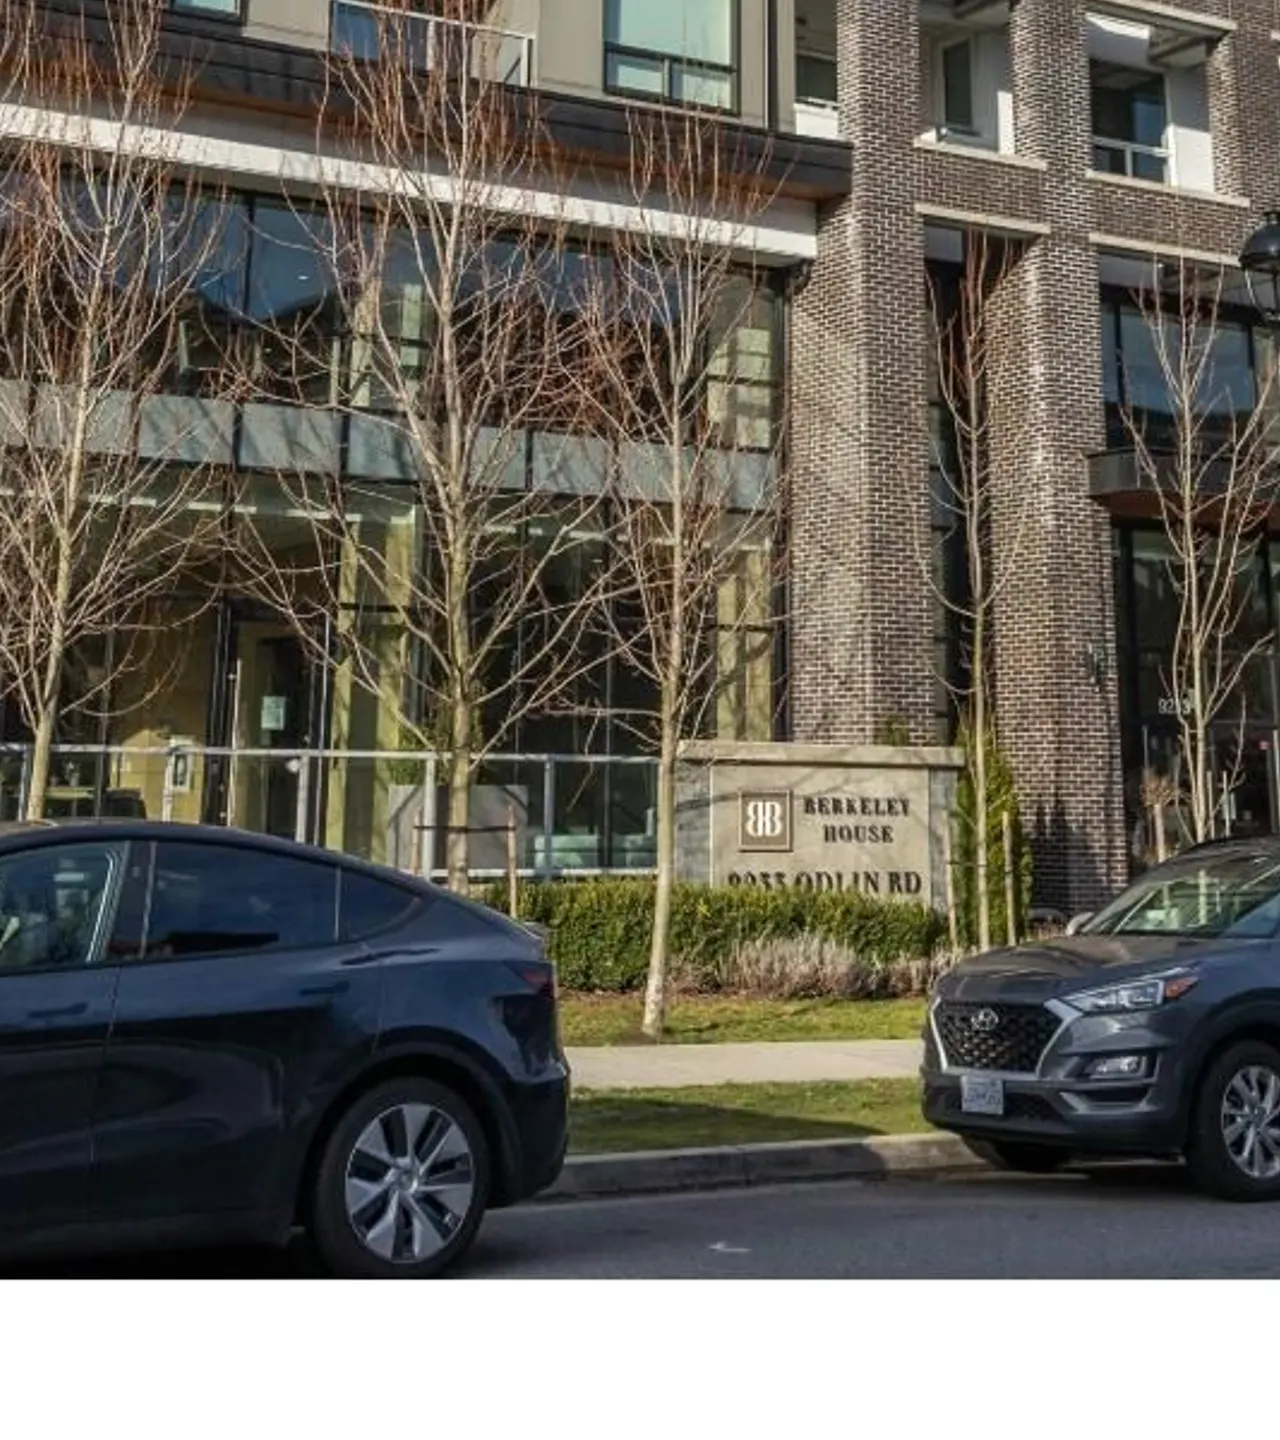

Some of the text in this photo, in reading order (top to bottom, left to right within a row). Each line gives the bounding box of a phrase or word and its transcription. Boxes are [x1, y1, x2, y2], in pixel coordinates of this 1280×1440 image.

[803, 796, 910, 817] BERKELEY
[823, 823, 894, 844] HOUSE
[887, 870, 923, 894] RD
